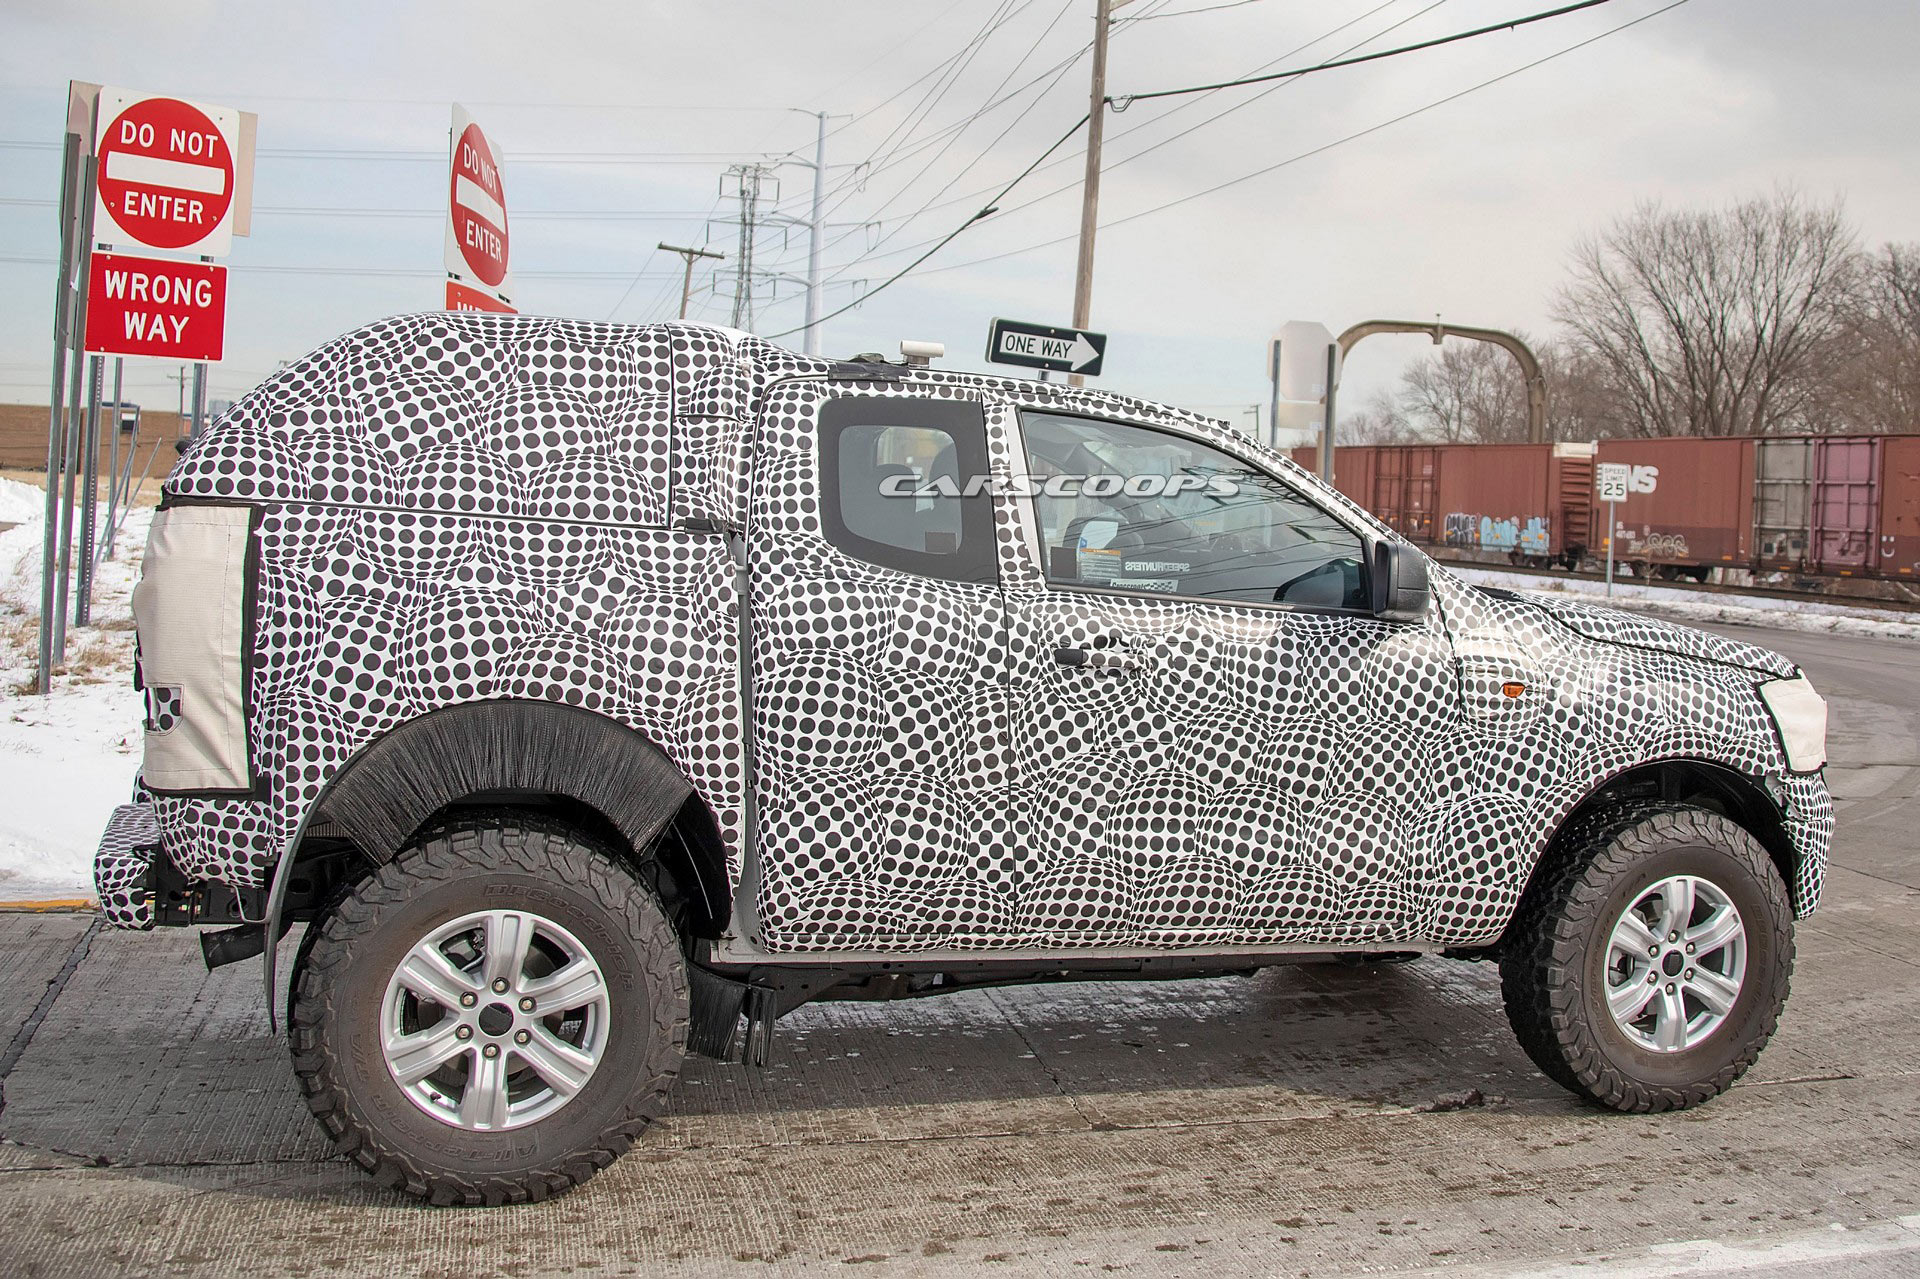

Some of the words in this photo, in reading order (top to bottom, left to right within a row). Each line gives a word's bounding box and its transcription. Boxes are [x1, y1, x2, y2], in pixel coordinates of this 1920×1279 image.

[120, 119, 155, 148] DO
[170, 128, 219, 158] NOT
[463, 142, 479, 175] DO
[481, 157, 497, 193] NOT
[124, 190, 204, 225] ENTER
[466, 219, 502, 263] ENTER
[104, 269, 212, 308] WRONG
[124, 311, 190, 344] WAY
[1005, 334, 1036, 354] ONE
[1042, 339, 1073, 359] WAY
[1604, 467, 1625, 475] SPEED
[1603, 482, 1625, 497] 25
